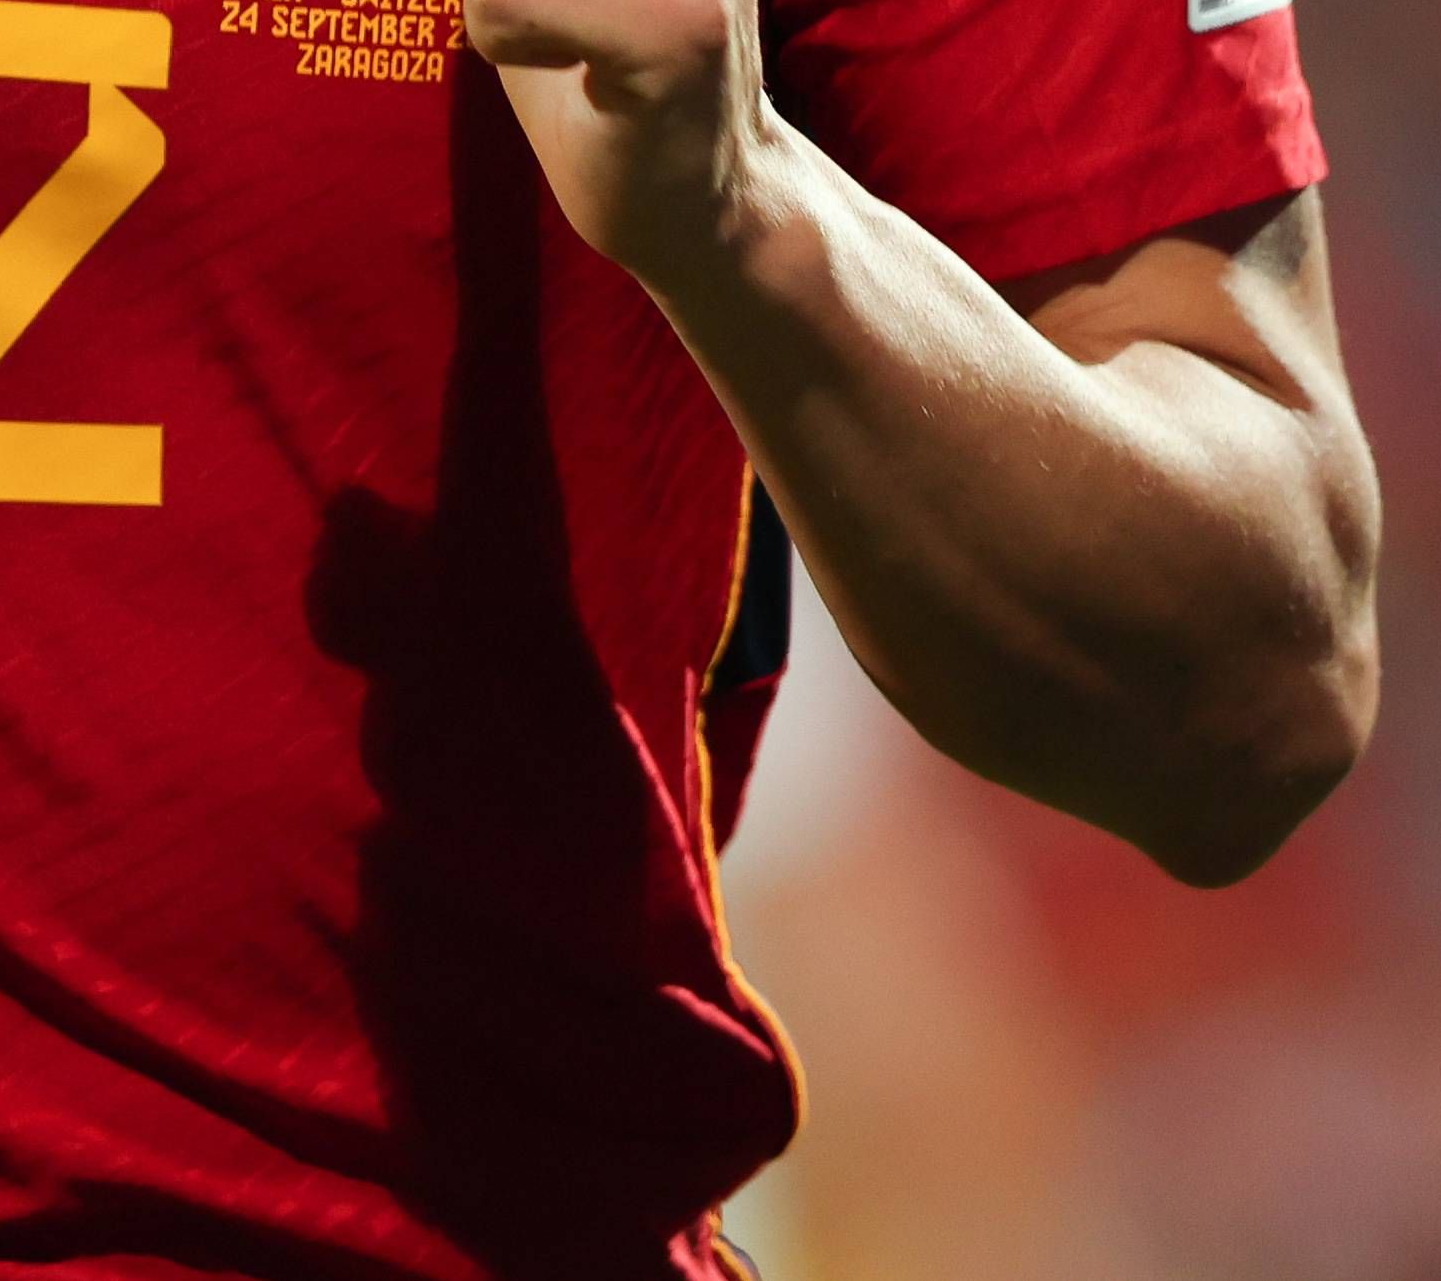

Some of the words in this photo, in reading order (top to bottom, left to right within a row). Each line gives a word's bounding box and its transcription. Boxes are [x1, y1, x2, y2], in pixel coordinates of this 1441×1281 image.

[220, 0, 259, 34] 24
[271, 5, 435, 48] SEPTEMBER
[446, 17, 465, 49] 2
[296, 43, 445, 83] ZARAGOZA
